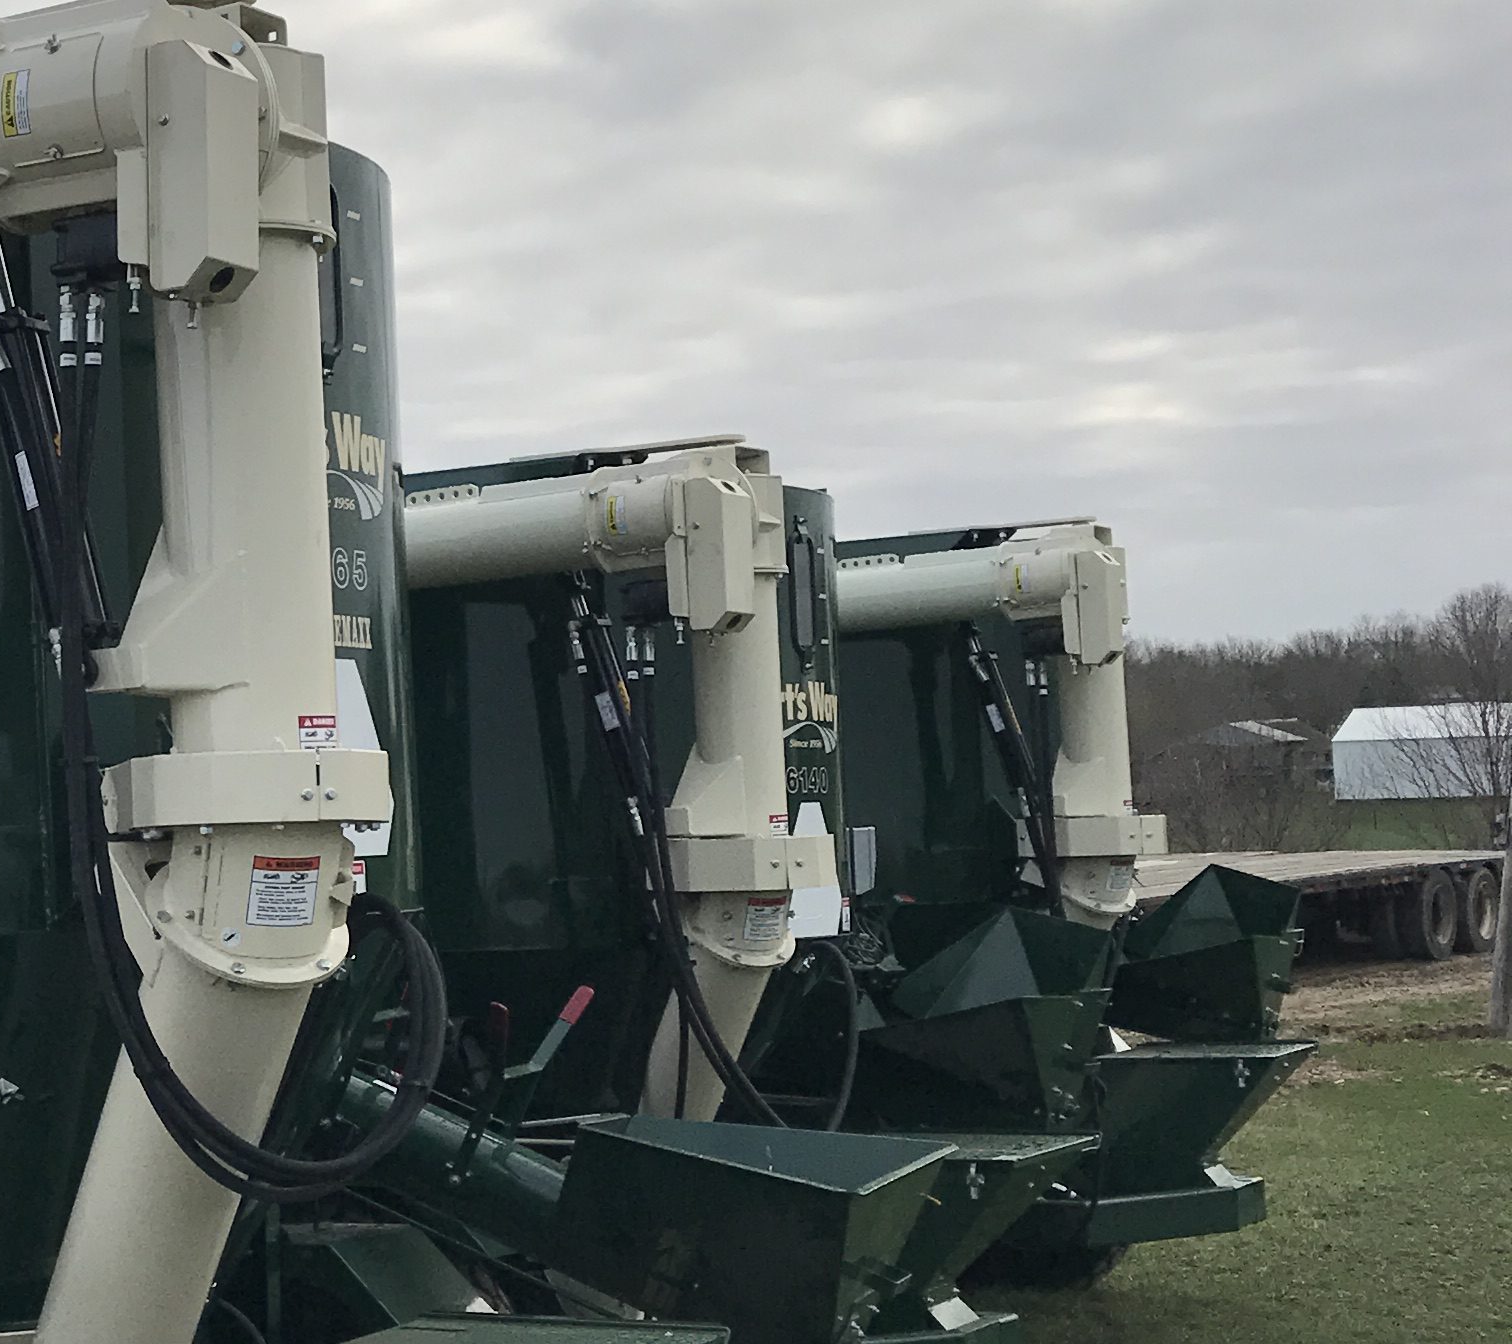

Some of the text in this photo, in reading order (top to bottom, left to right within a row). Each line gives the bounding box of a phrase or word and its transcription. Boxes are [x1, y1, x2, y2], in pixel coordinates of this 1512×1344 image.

[331, 411, 386, 494] Way
[333, 497, 356, 510] 1956
[331, 547, 368, 590] 65
[808, 681, 838, 732] Way
[786, 767, 828, 794] 6140
